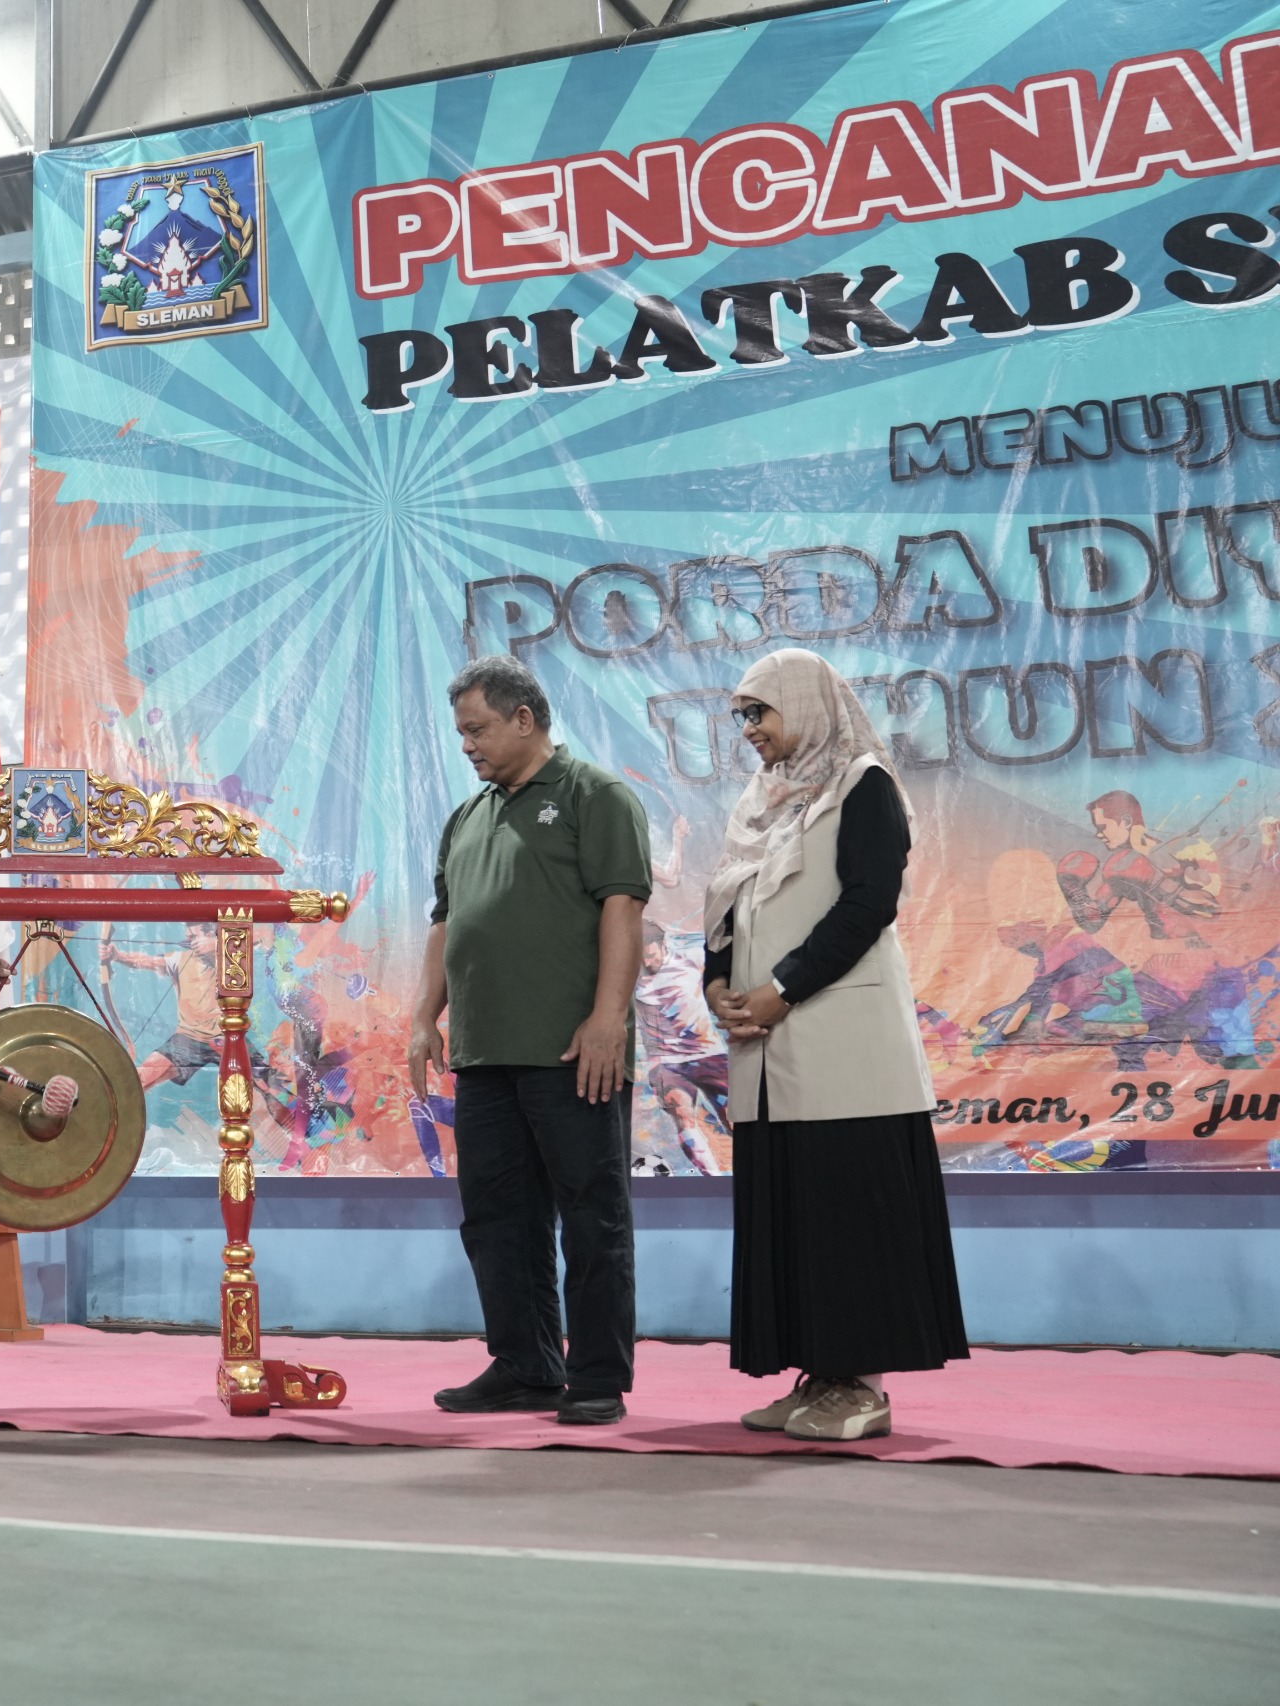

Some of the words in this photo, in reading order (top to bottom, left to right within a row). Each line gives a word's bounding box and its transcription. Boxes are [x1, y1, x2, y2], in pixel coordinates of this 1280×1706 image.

[136, 304, 214, 328] SLEMAN
[358, 237, 1141, 414] PELATKAB
[1163, 206, 1280, 309] S
[890, 378, 1280, 483] MENUJU
[463, 530, 1002, 661] PORDA
[646, 648, 1214, 785] THUN
[31, 842, 70, 851] SLEMAN
[930, 1095, 1090, 1130] eman,
[1109, 1080, 1175, 1123] 28
